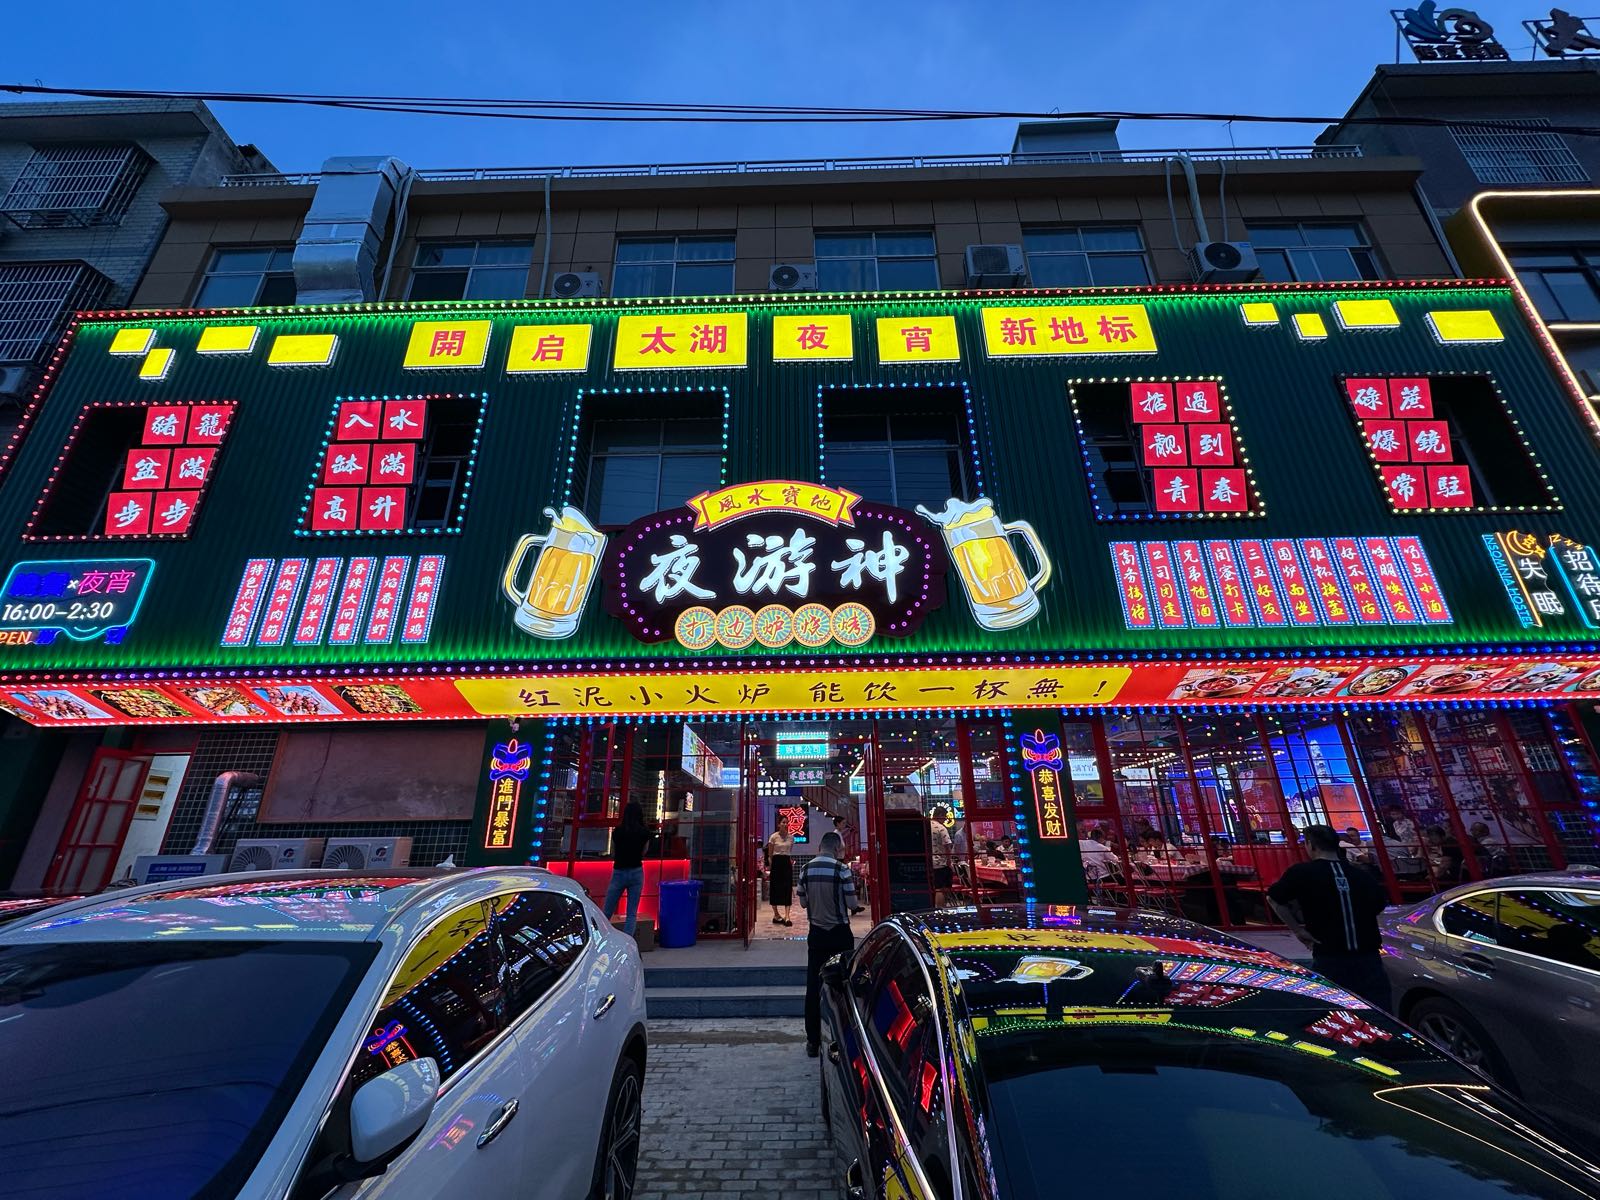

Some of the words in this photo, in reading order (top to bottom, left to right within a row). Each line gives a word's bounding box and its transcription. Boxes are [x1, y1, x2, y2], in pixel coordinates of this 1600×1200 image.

[430, 330, 466, 357] 開
[531, 335, 565, 362] 启
[640, 325, 727, 354] 太湖
[796, 324, 829, 350] 夜
[901, 326, 933, 353] 宵
[1000, 315, 1138, 346] 新地标
[344, 408, 419, 431] 入水
[114, 498, 190, 528] 步步
[323, 495, 397, 522] 高升
[1163, 476, 1239, 504] 青春
[336, 562, 366, 637] 香辣大闸蟹
[372, 561, 401, 636] 火焰香辣虾
[408, 560, 436, 636] 经典猪肚鸡
[639, 527, 910, 605] 夜游神
[1214, 547, 1245, 618] 闺蜜打卡
[1248, 548, 1279, 616] 三五好友
[1340, 546, 1376, 615] 好不快活
[1519, 557, 1565, 615] 失眠
[228, 564, 265, 640] 特色烈火烧烤
[264, 564, 298, 638] 红烧牛肉筋
[300, 563, 332, 638] 炭炉涮羊肉
[518, 684, 773, 709] 红泥小火炉
[492, 778, 515, 846] 進門暴富
[1038, 768, 1062, 836] 恭喜发财
